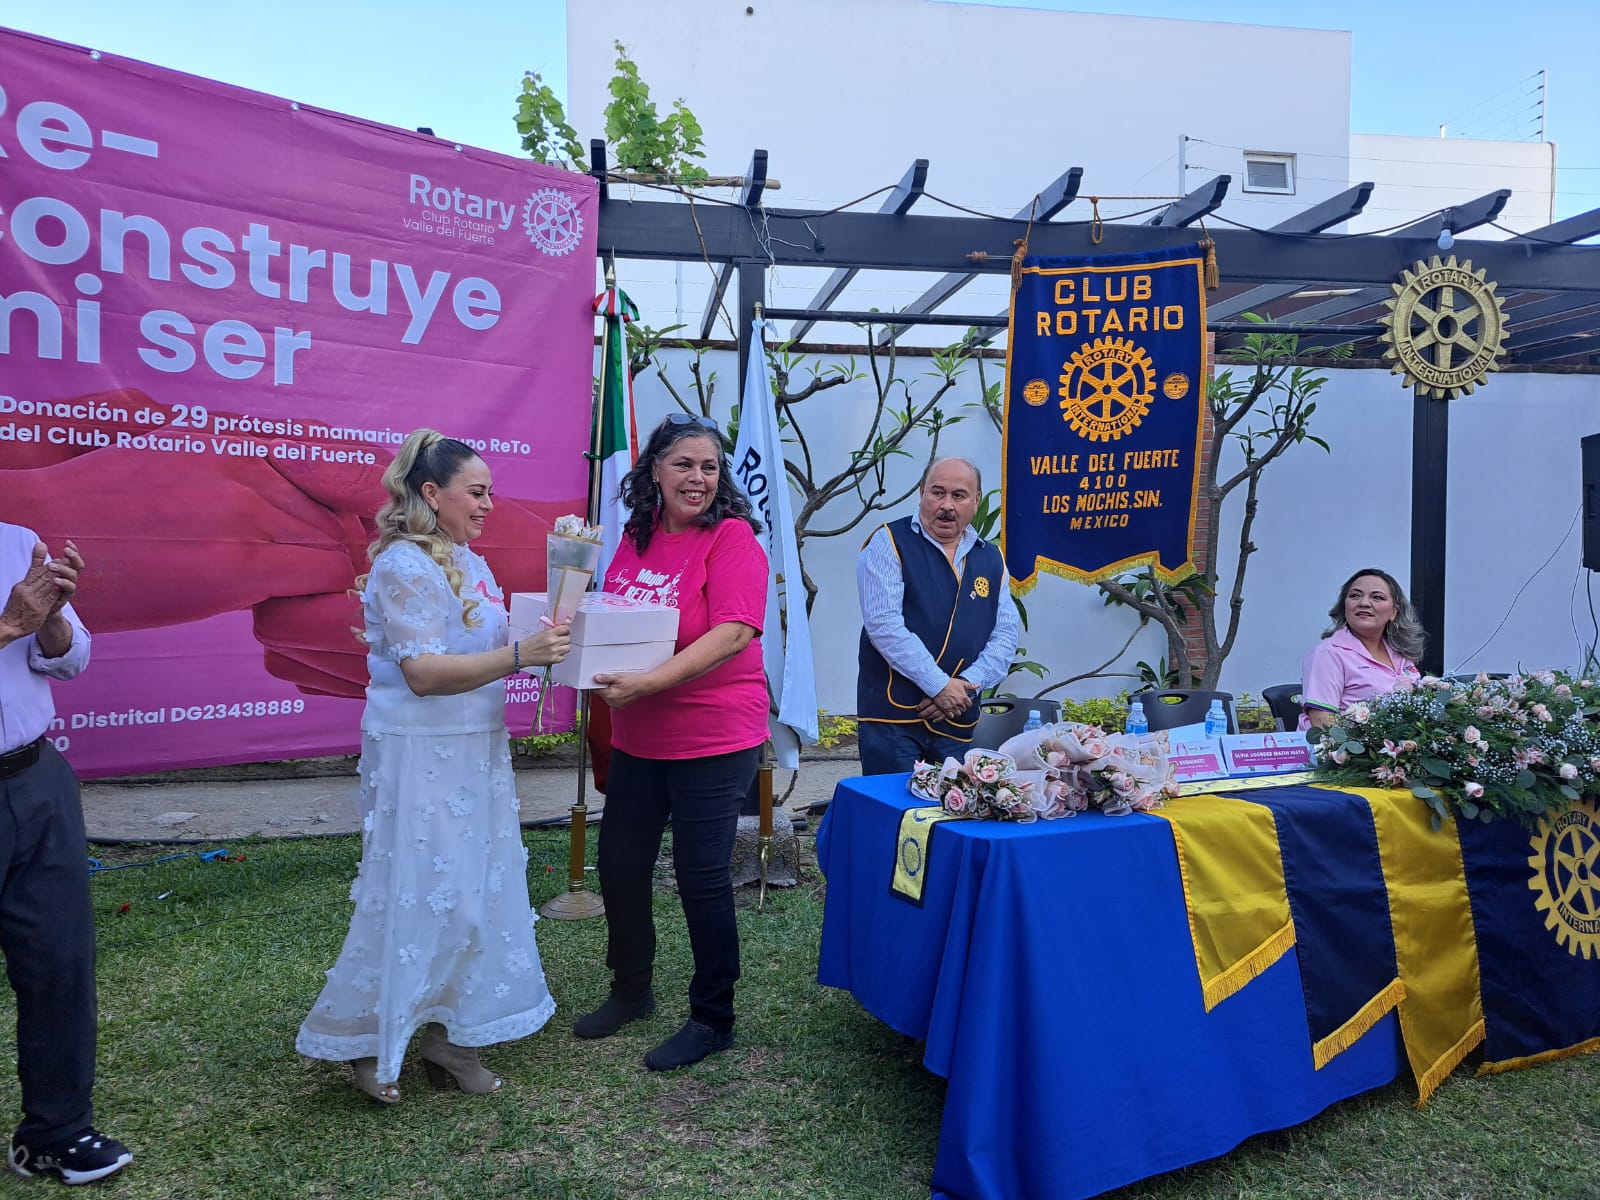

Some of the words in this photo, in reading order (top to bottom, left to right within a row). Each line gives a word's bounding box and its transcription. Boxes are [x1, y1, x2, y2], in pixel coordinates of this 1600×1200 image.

[0, 83, 158, 170] e-
[410, 173, 516, 230] Rotary
[403, 216, 433, 233] Valle
[436, 224, 455, 238] del
[458, 229, 495, 245] Fuerte
[422, 210, 450, 225] Club
[454, 216, 495, 234] Rotario
[0, 197, 502, 344] onstruye
[1421, 270, 1481, 289] ROTARY
[1055, 275, 1152, 305] CLUB
[1037, 305, 1184, 337] ROTARIO
[137, 310, 312, 385] ser
[1084, 350, 1133, 367] ROTARY
[1402, 342, 1493, 385] INTERNATIONAL
[0, 395, 128, 423] Donación
[134, 407, 166, 425] de
[171, 404, 208, 428] 29
[214, 415, 304, 437] prótesis
[490, 438, 531, 455] ReTo
[1071, 400, 1143, 433] INTERNATIONAL
[0, 422, 41, 443] del
[48, 427, 110, 447] Club
[116, 432, 206, 455] Rotario
[211, 438, 268, 458] Valle
[273, 443, 306, 461] del
[311, 446, 376, 466] Fuerte
[1030, 455, 1080, 475] VALLE
[1088, 453, 1115, 473] DEL
[1123, 449, 1180, 470] FUERTE
[1079, 474, 1127, 490] 4100
[1042, 495, 1070, 514] LOS
[1069, 514, 1130, 530] MEXICO
[71, 708, 165, 729] Distrital
[171, 699, 305, 723] DG23438889
[1557, 814, 1587, 832] ROTARY
[1559, 903, 1600, 935] INTERNA
